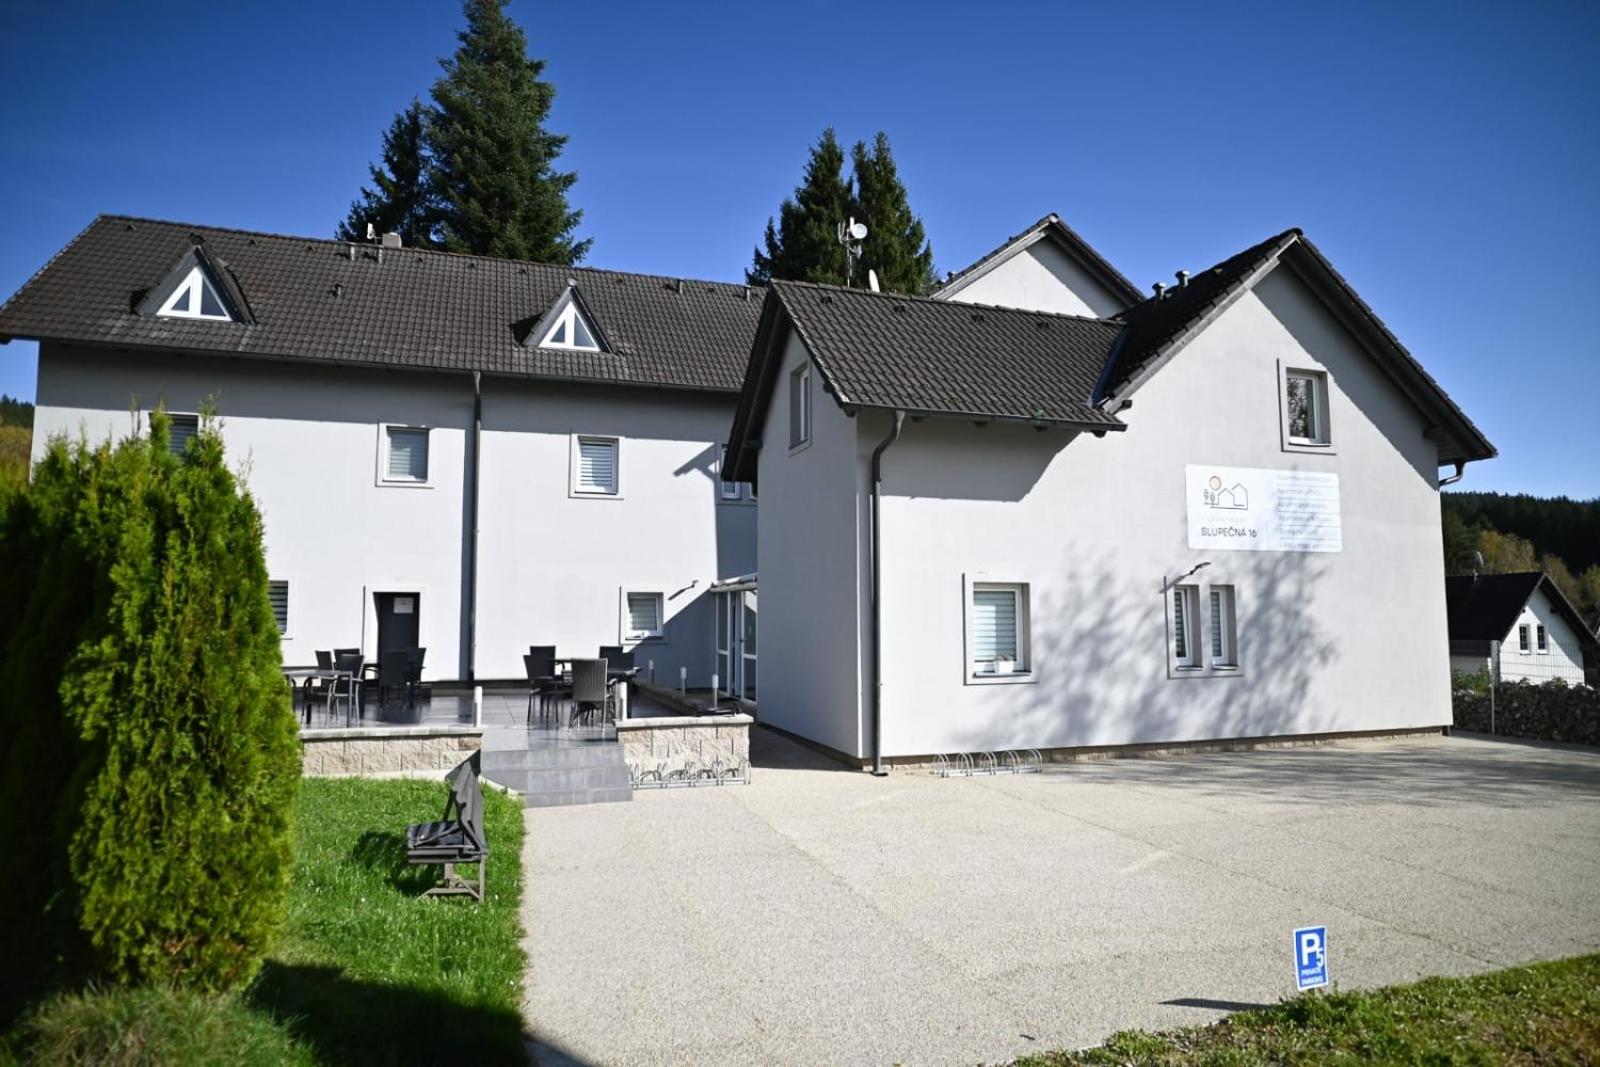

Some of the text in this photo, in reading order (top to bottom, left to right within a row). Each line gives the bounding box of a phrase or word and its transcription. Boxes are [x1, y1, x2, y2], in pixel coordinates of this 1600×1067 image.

[1201, 525, 1258, 538] SLUPEČNÁ 16
[1301, 933, 1320, 966] P
[1316, 947, 1324, 967] 5
